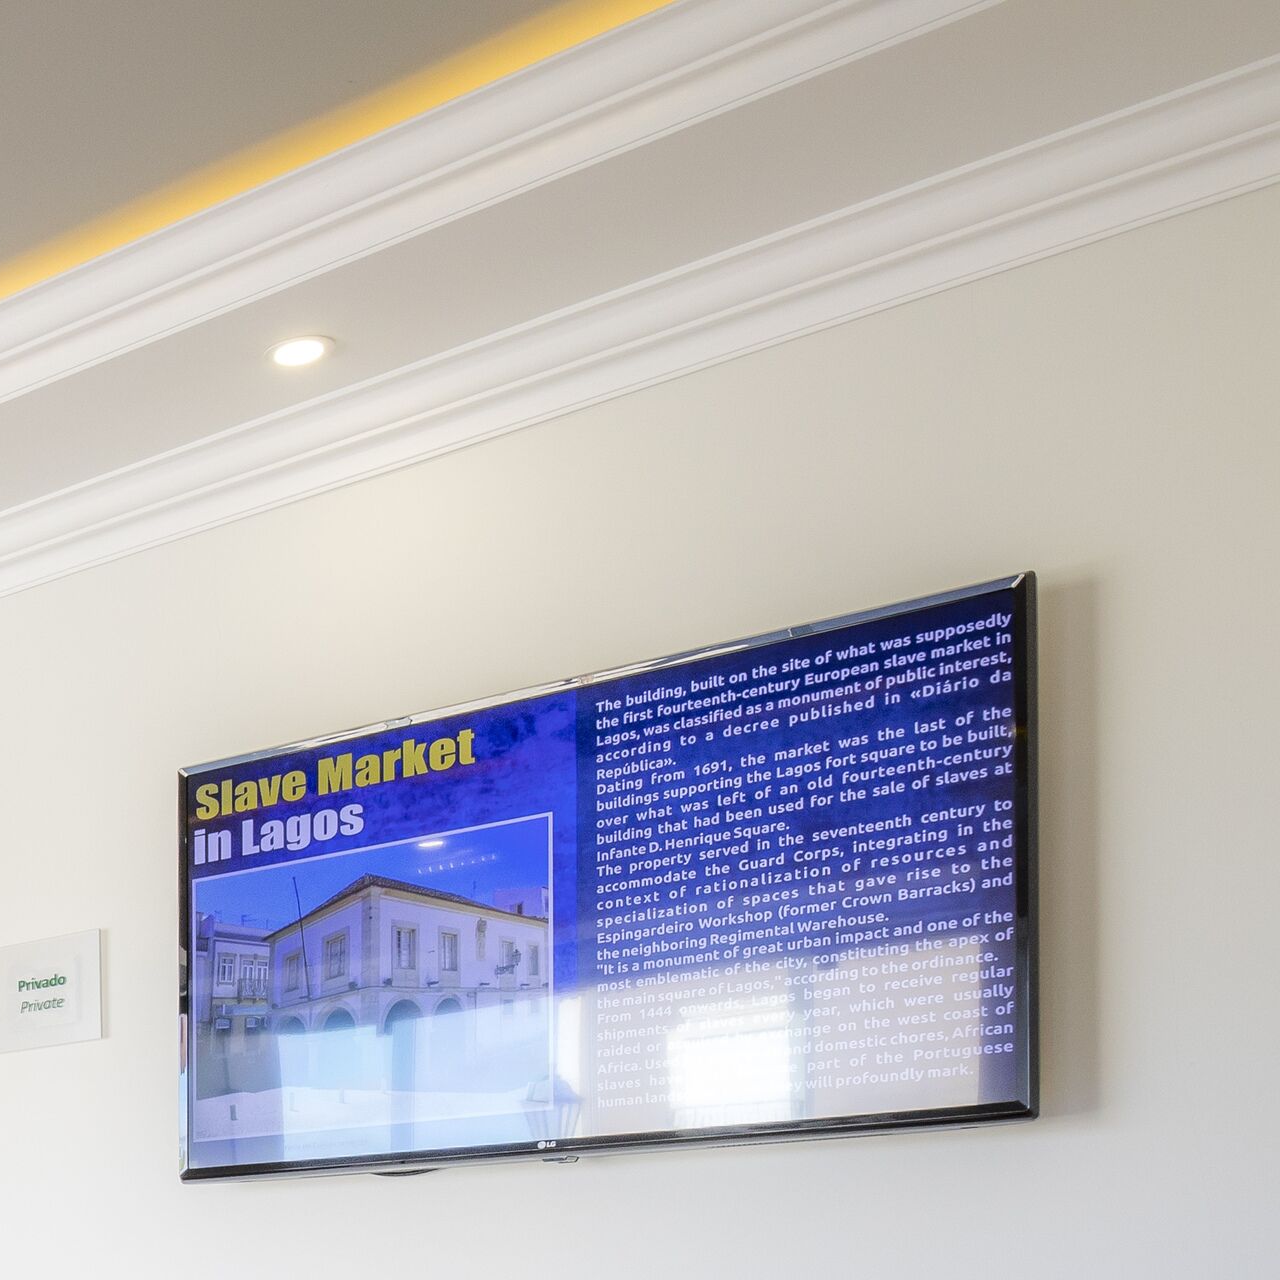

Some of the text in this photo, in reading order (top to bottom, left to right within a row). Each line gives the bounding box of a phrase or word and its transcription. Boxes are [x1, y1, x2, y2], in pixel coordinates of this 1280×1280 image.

[595, 613, 1012, 713] The building, built on the site of what was supposedly
[596, 632, 1012, 730] the first fourteenth-century European slave market in
[596, 651, 1012, 747] Lagos, was classified as a monument of public interest,
[596, 670, 1012, 764] according to a decree published in «Diário da
[596, 707, 1012, 796] Dating from 1691, the market was the last of the
[195, 728, 476, 821] Slave Market
[596, 725, 1013, 812] buildings supporting the Lagos fort square to be built,
[596, 757, 677, 781] República».
[596, 744, 1013, 829] over what was left of an old fourteenth-century
[193, 803, 365, 866] in Lagos
[17, 973, 67, 993] Privado
[20, 997, 66, 1014] Private
[546, 1140, 557, 1148] LG
